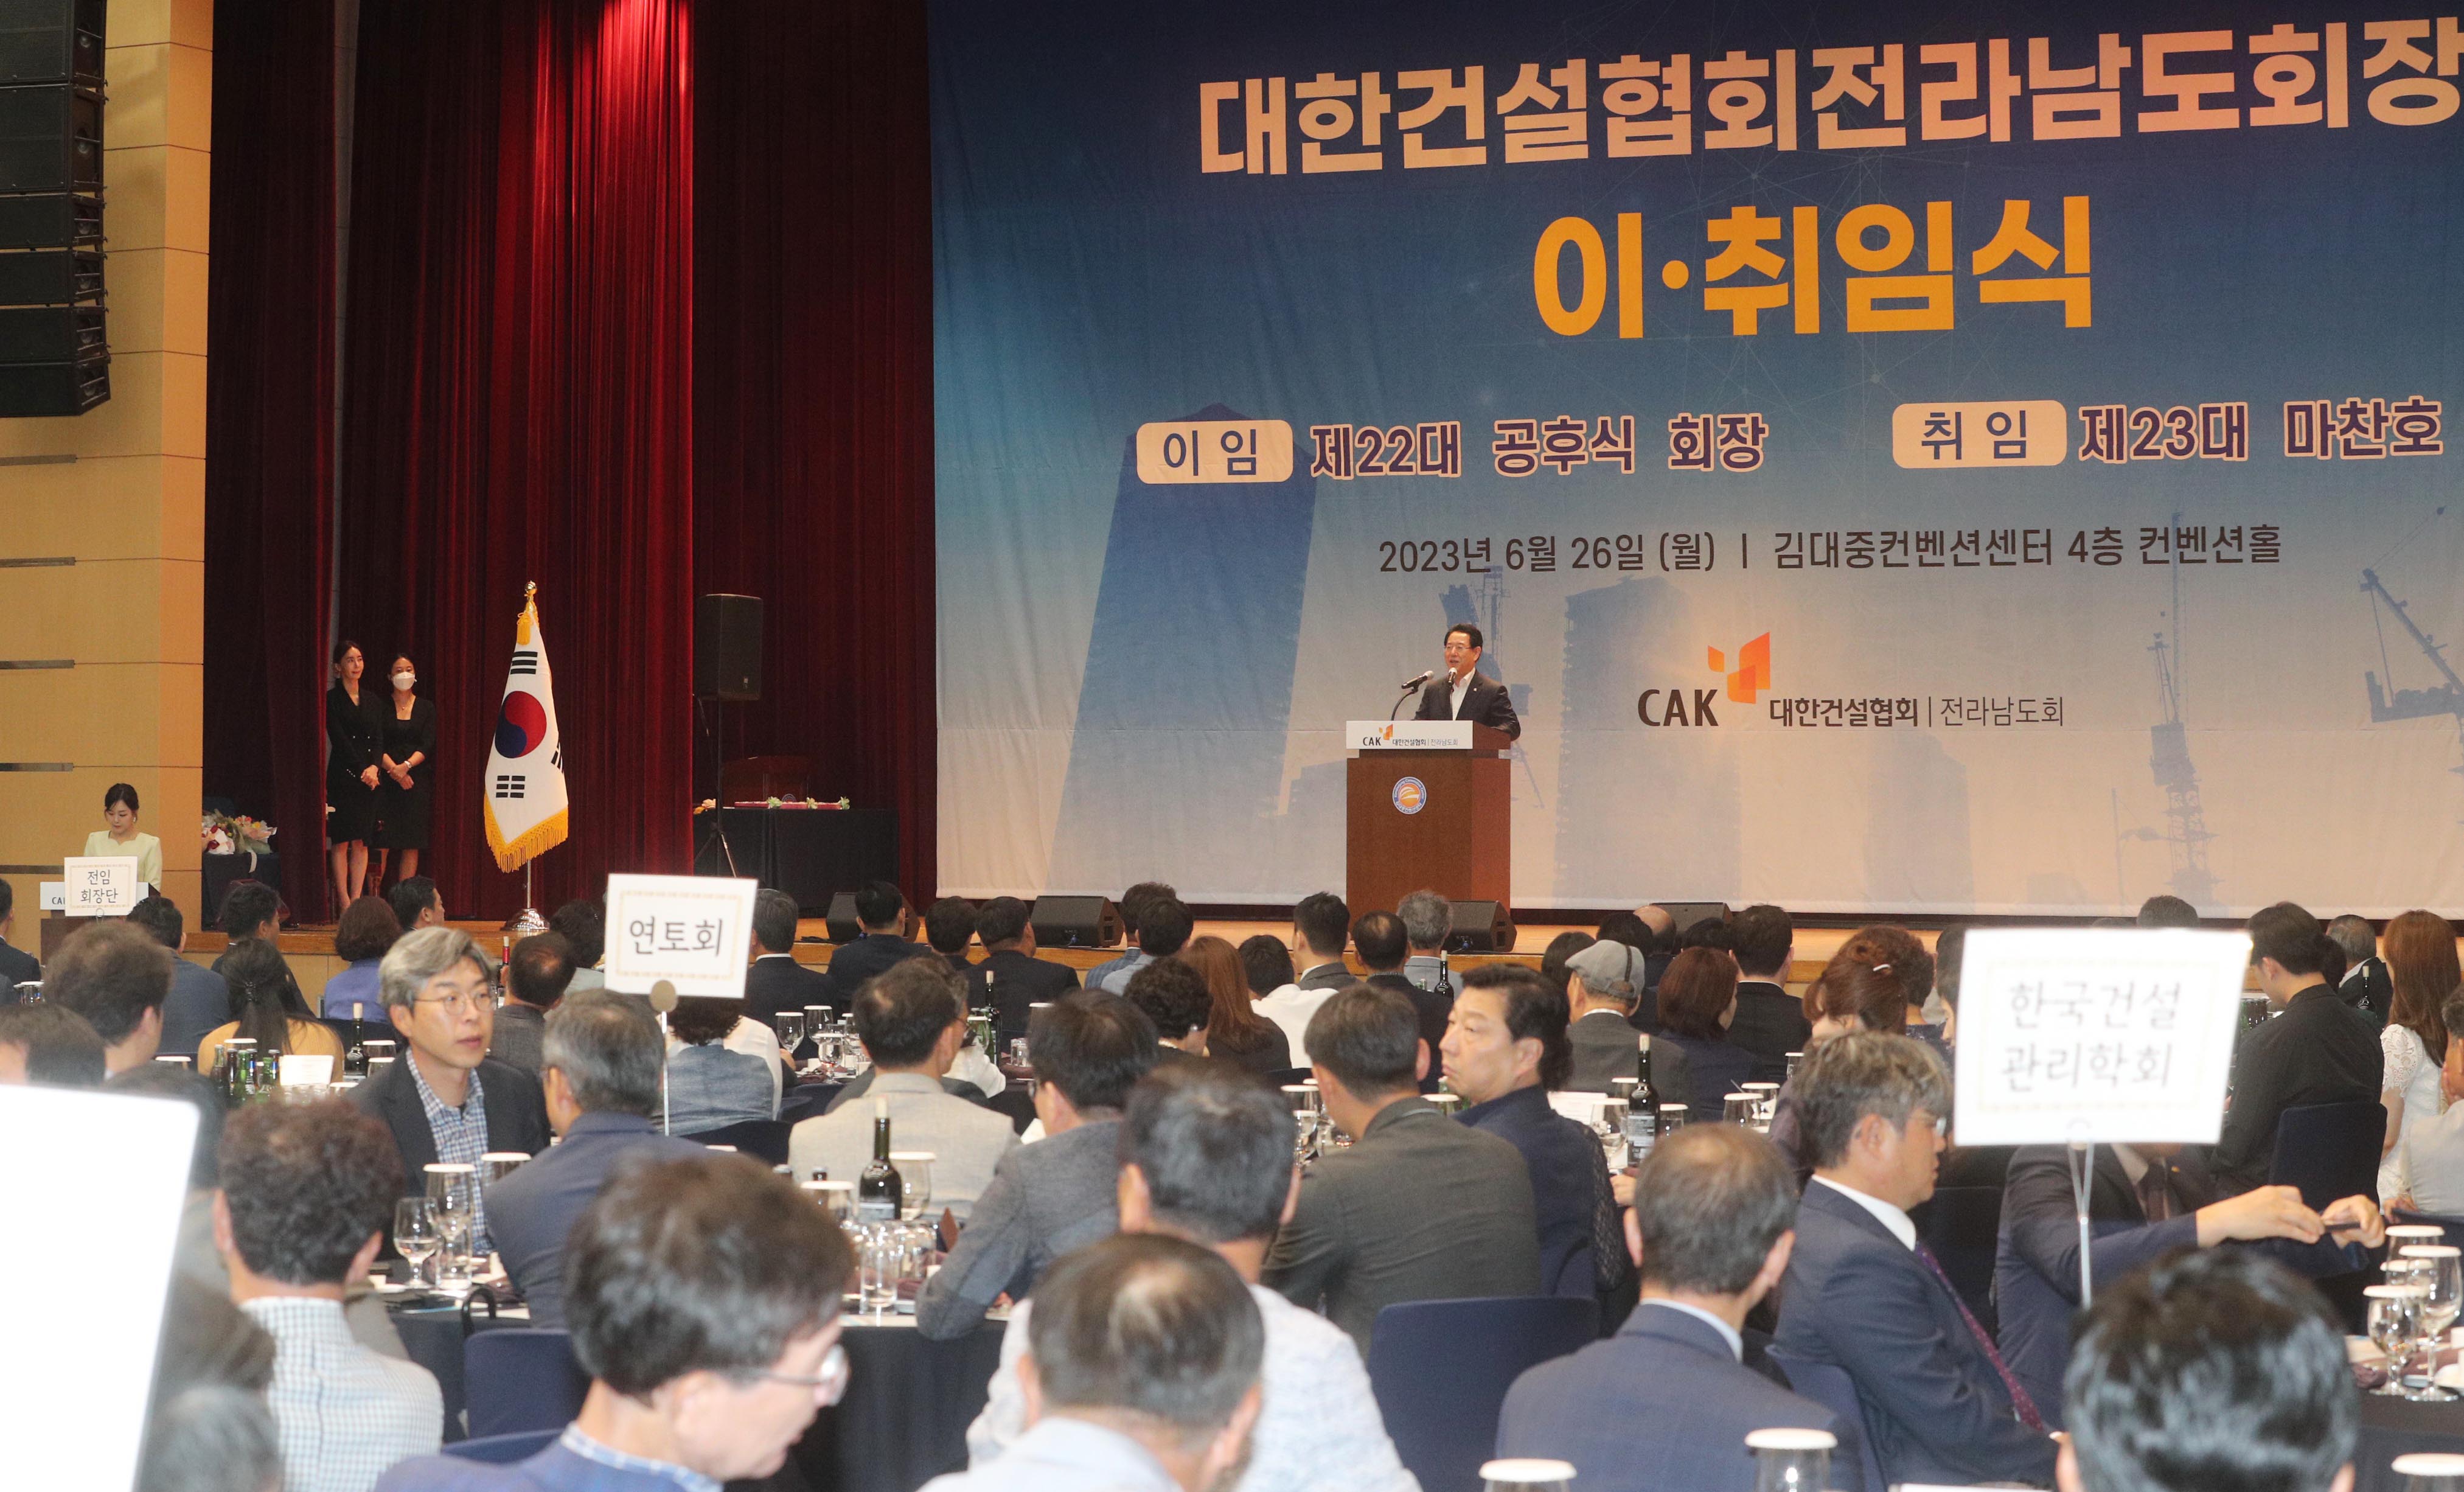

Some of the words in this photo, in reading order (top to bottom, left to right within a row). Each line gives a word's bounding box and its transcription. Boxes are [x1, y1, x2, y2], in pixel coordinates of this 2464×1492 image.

[1200, 17, 2464, 175] 대한건설협회전라남도회장
[1534, 196, 2091, 338] 이·취임식
[1310, 421, 1461, 480] 제22대
[1492, 415, 1635, 477] 공후식
[1668, 413, 1769, 472] 회장
[2078, 403, 2247, 464] 제23대
[2284, 396, 2443, 460] 마찬호
[1379, 537, 1491, 573] 2023년
[1506, 535, 1556, 572] 6월
[1571, 534, 1643, 570] 26일
[1659, 532, 1715, 571] (월)
[1774, 529, 2052, 569] 김대중컨벤션센터
[2068, 527, 2124, 566] 4층
[2139, 524, 2281, 565] 컨벤션홀
[1637, 689, 1719, 727] CAK
[1770, 697, 1918, 727] 대한건설협회
[1940, 696, 2063, 727] 전라남도회
[1362, 737, 1381, 746] CAK
[52, 896, 65, 905] CA
[80, 888, 119, 904] 회장단
[88, 870, 111, 885] 전임
[630, 916, 723, 957] 연토회
[2010, 980, 2181, 1030] 한국건설
[2002, 1042, 2173, 1093] 관리학회
